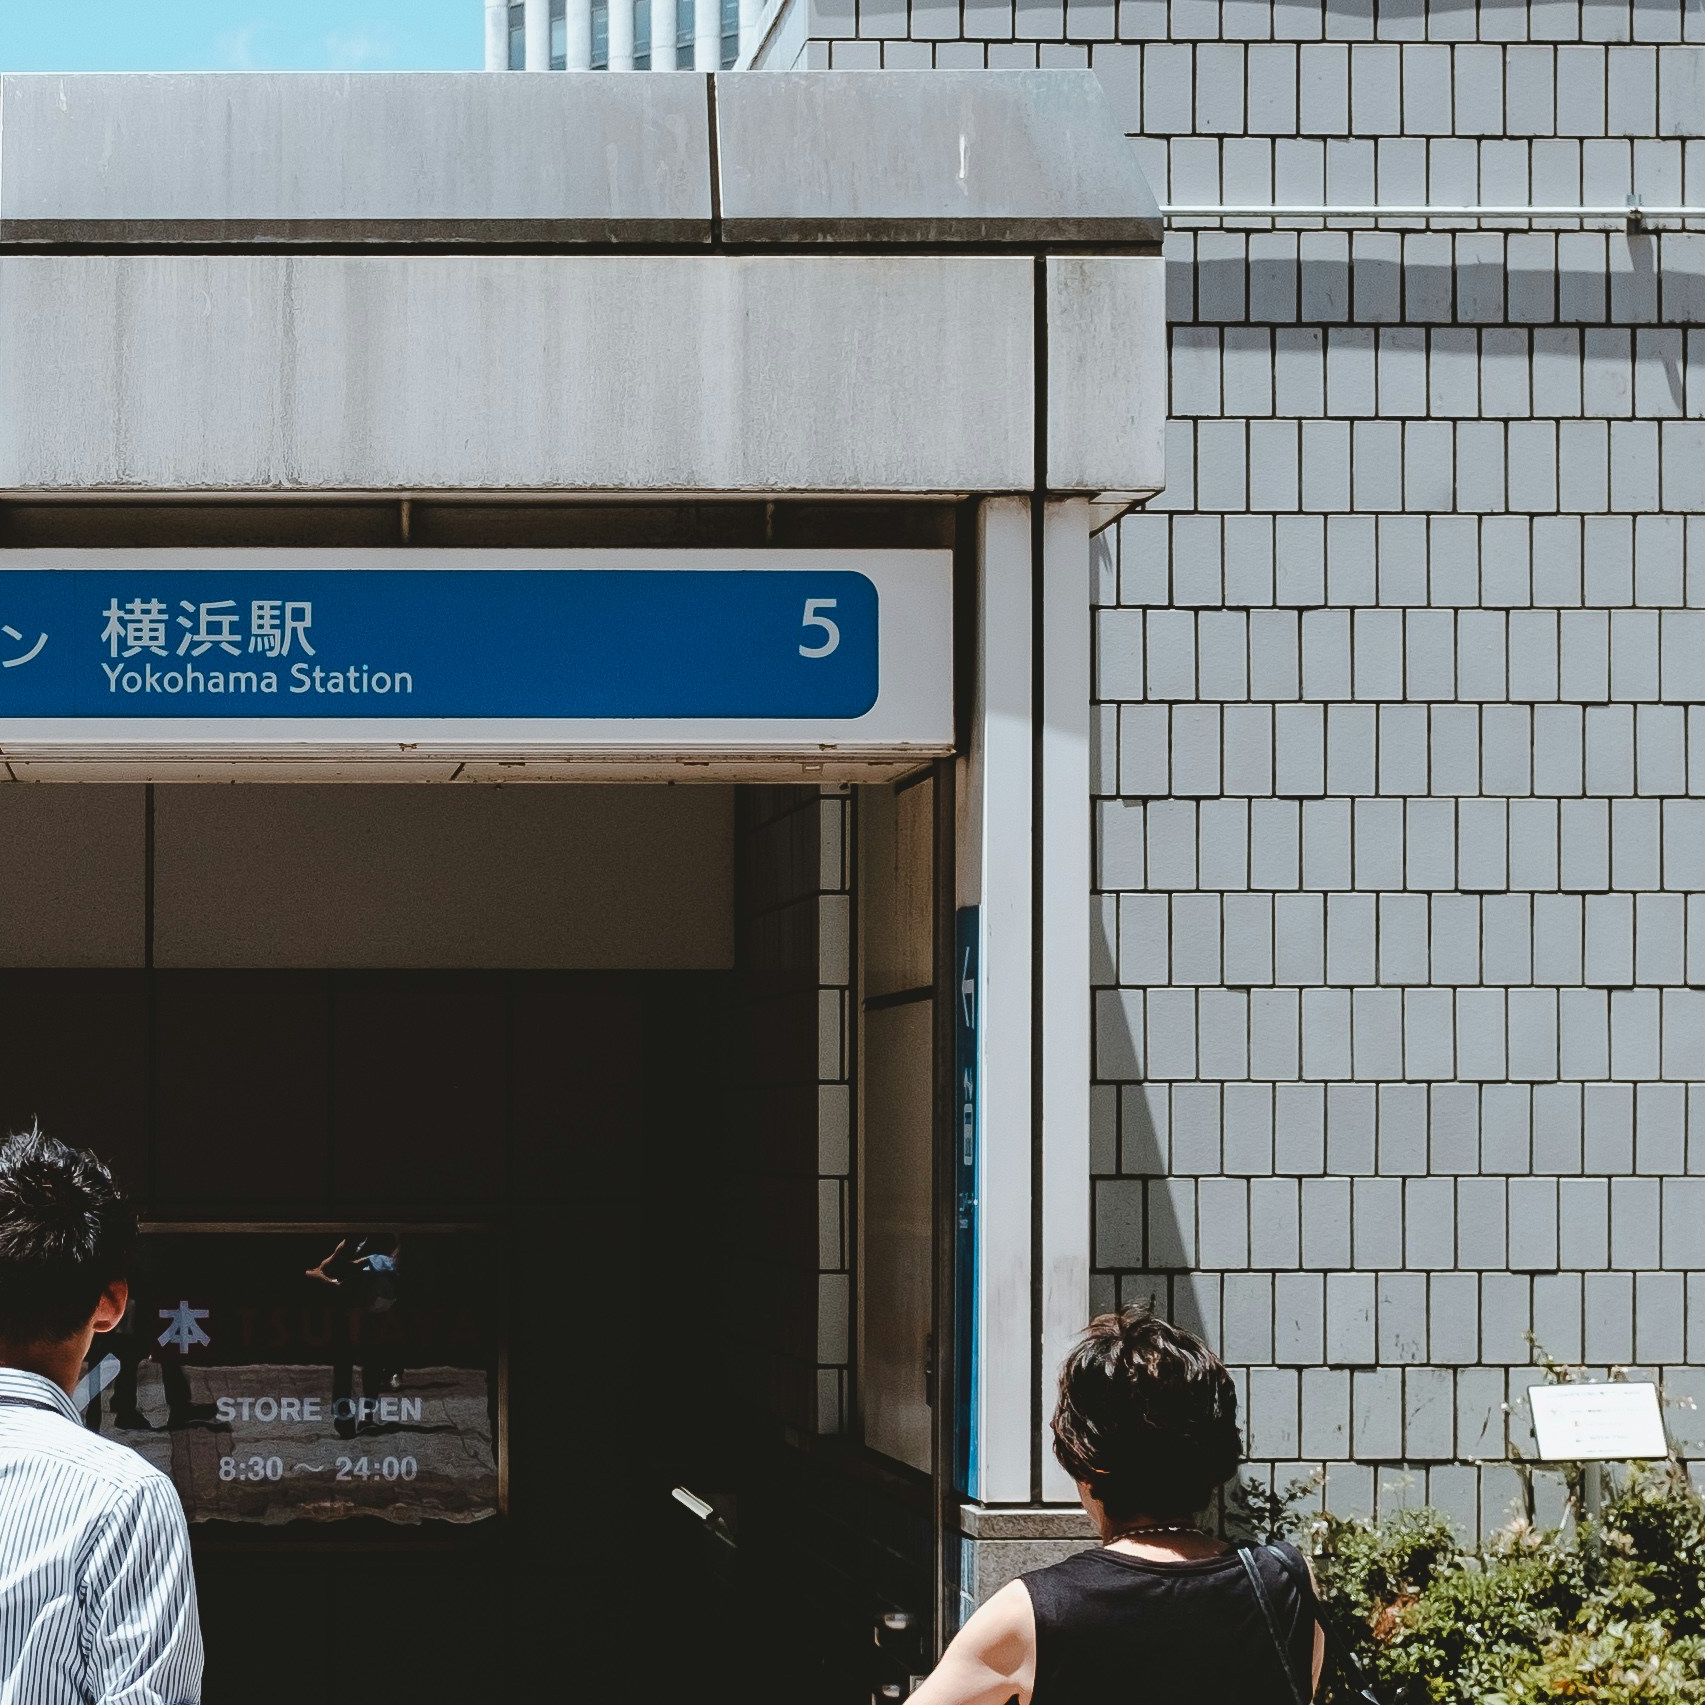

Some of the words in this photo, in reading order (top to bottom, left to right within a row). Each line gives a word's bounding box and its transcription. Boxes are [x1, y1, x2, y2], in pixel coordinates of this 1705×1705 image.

[100, 598, 316, 658] 横浜駅
[798, 598, 841, 659] 5
[100, 662, 278, 694] Yokohama
[289, 662, 414, 694] Station
[215, 1397, 322, 1423] STORE
[332, 1397, 422, 1423] OPEN
[218, 1456, 284, 1482] 8:30
[335, 1456, 418, 1482] 24:00
